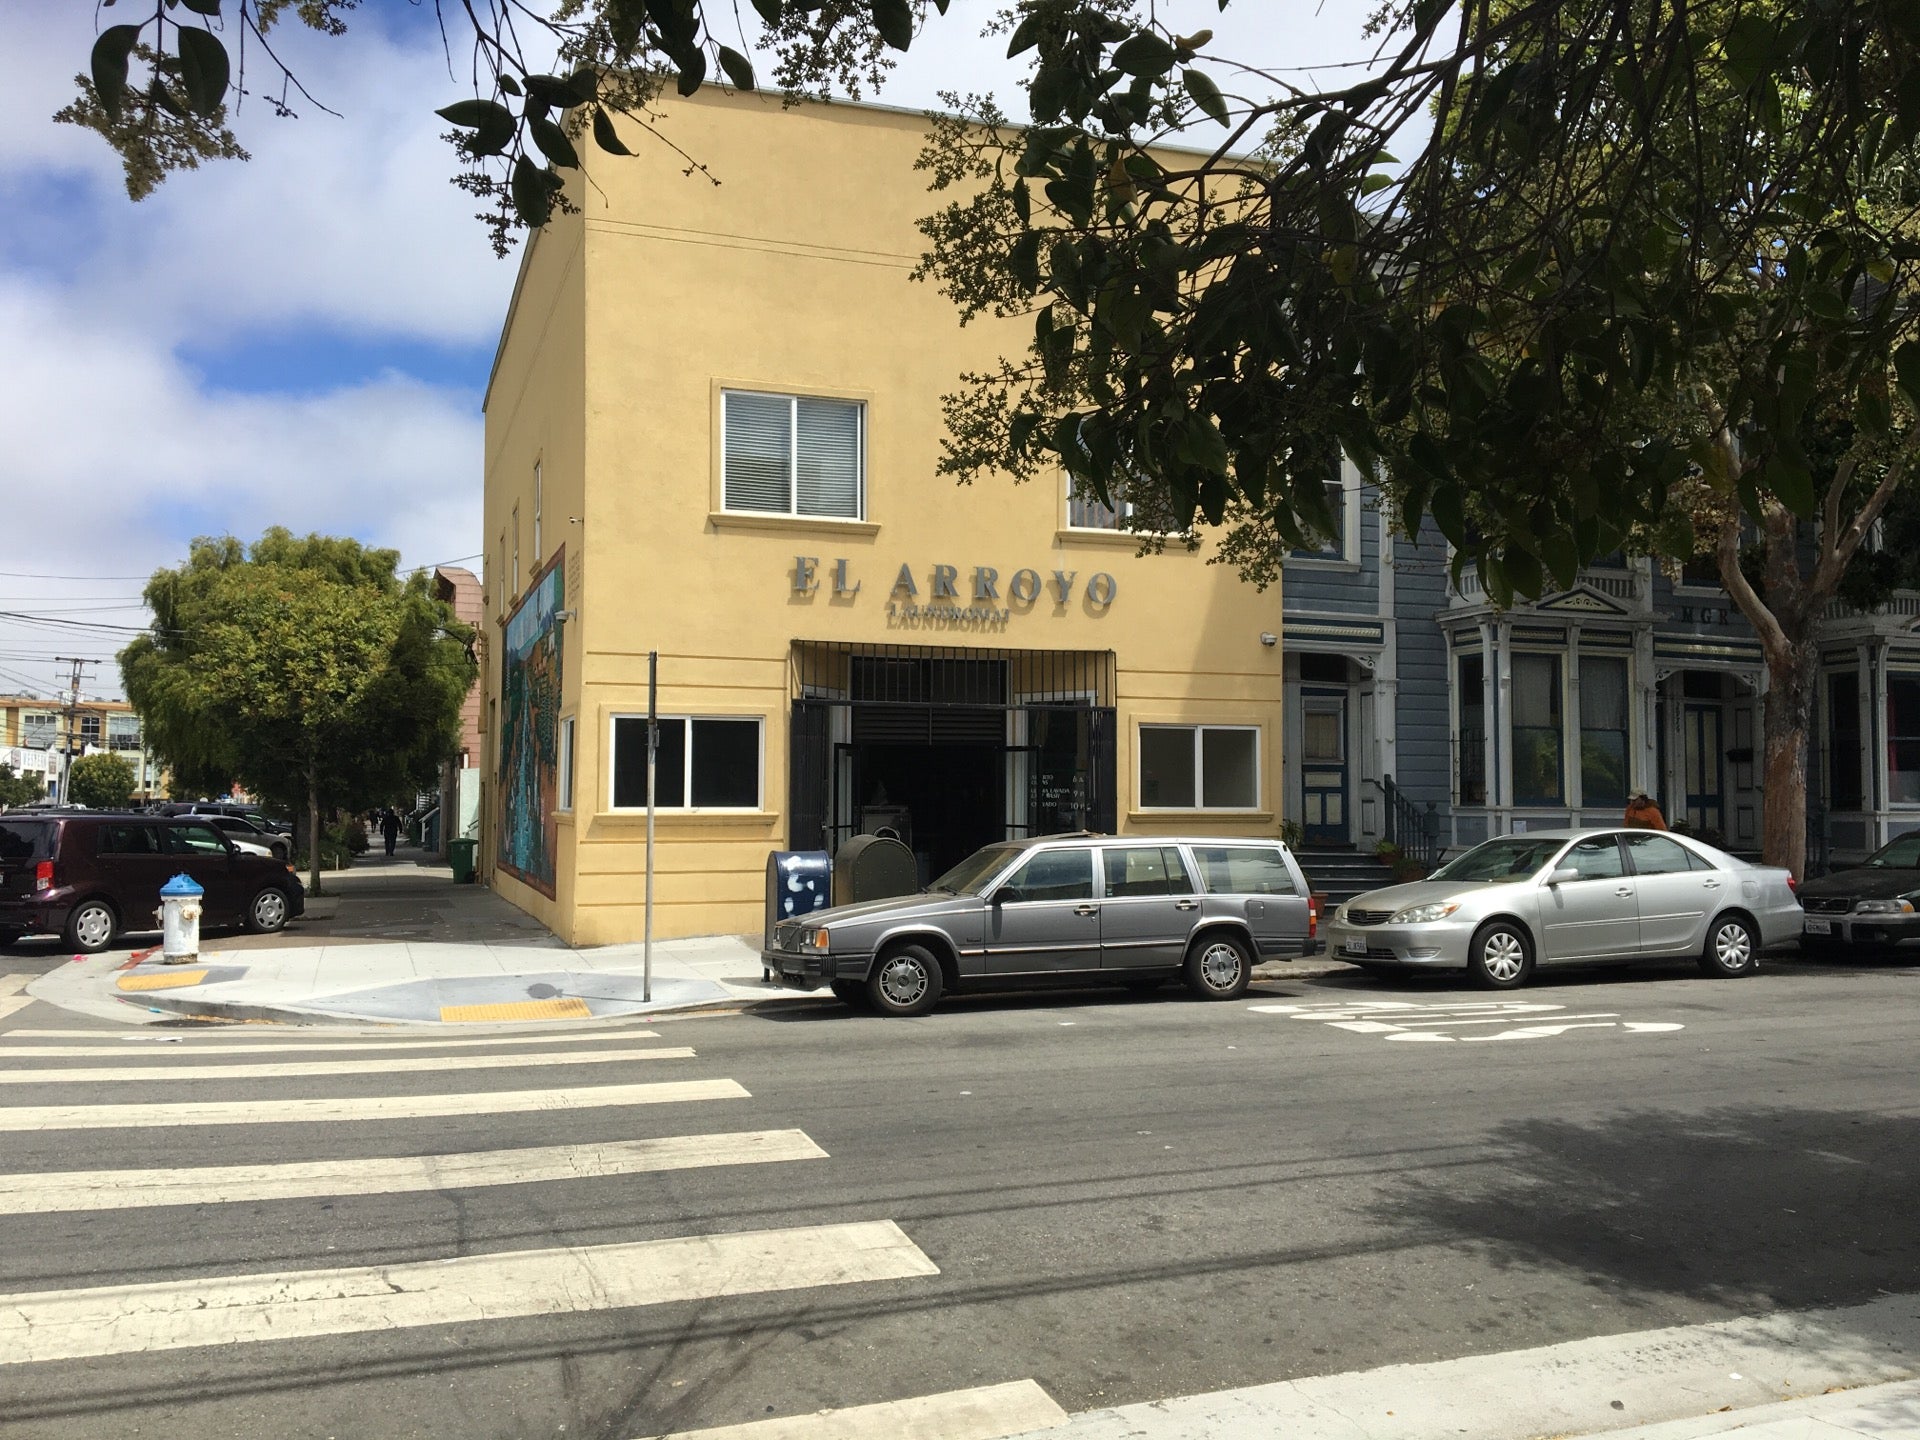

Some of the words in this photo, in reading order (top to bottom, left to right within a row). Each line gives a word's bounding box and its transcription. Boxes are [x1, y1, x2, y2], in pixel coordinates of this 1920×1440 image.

[793, 556, 861, 593] EL
[892, 562, 1117, 606] ARROYO
[888, 602, 1011, 625] LAUNDROMAT
[1247, 1001, 1686, 1042] STOP
